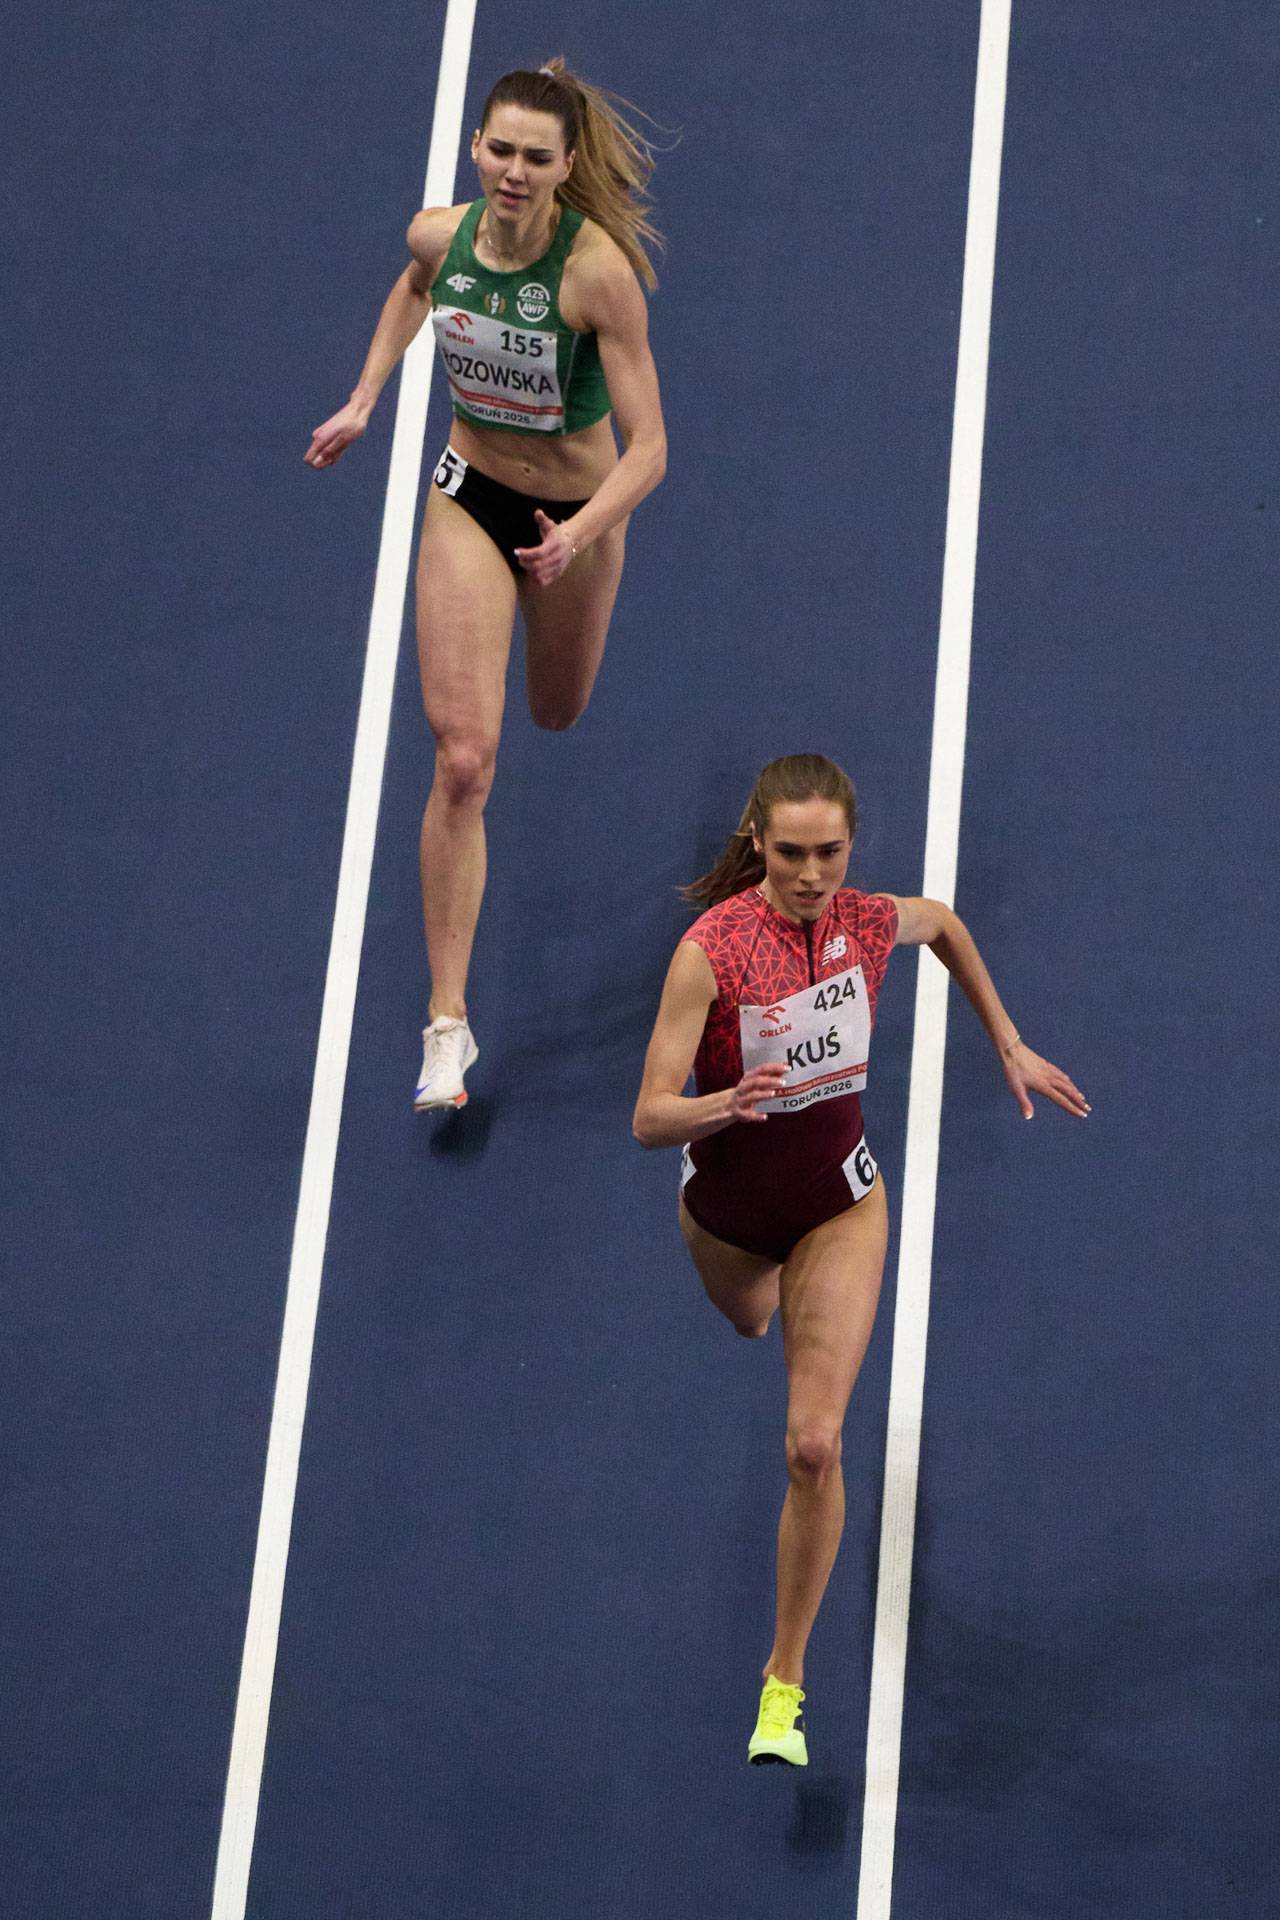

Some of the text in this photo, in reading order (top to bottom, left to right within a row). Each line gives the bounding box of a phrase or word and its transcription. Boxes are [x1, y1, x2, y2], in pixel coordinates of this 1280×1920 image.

[446, 273, 477, 293] 4F
[525, 288, 545, 300] AZS
[521, 303, 546, 315] AWF
[445, 330, 474, 345] ORLEN
[501, 329, 543, 358] 155
[503, 410, 531, 424] 2026
[435, 450, 458, 489] 5
[814, 977, 856, 1012] 424
[759, 1023, 792, 1038] ORLEN
[787, 1025, 841, 1071] KUŚ
[781, 1087, 821, 1108] TORUŃ
[823, 1080, 852, 1096] 2026
[855, 1146, 875, 1187] 6
